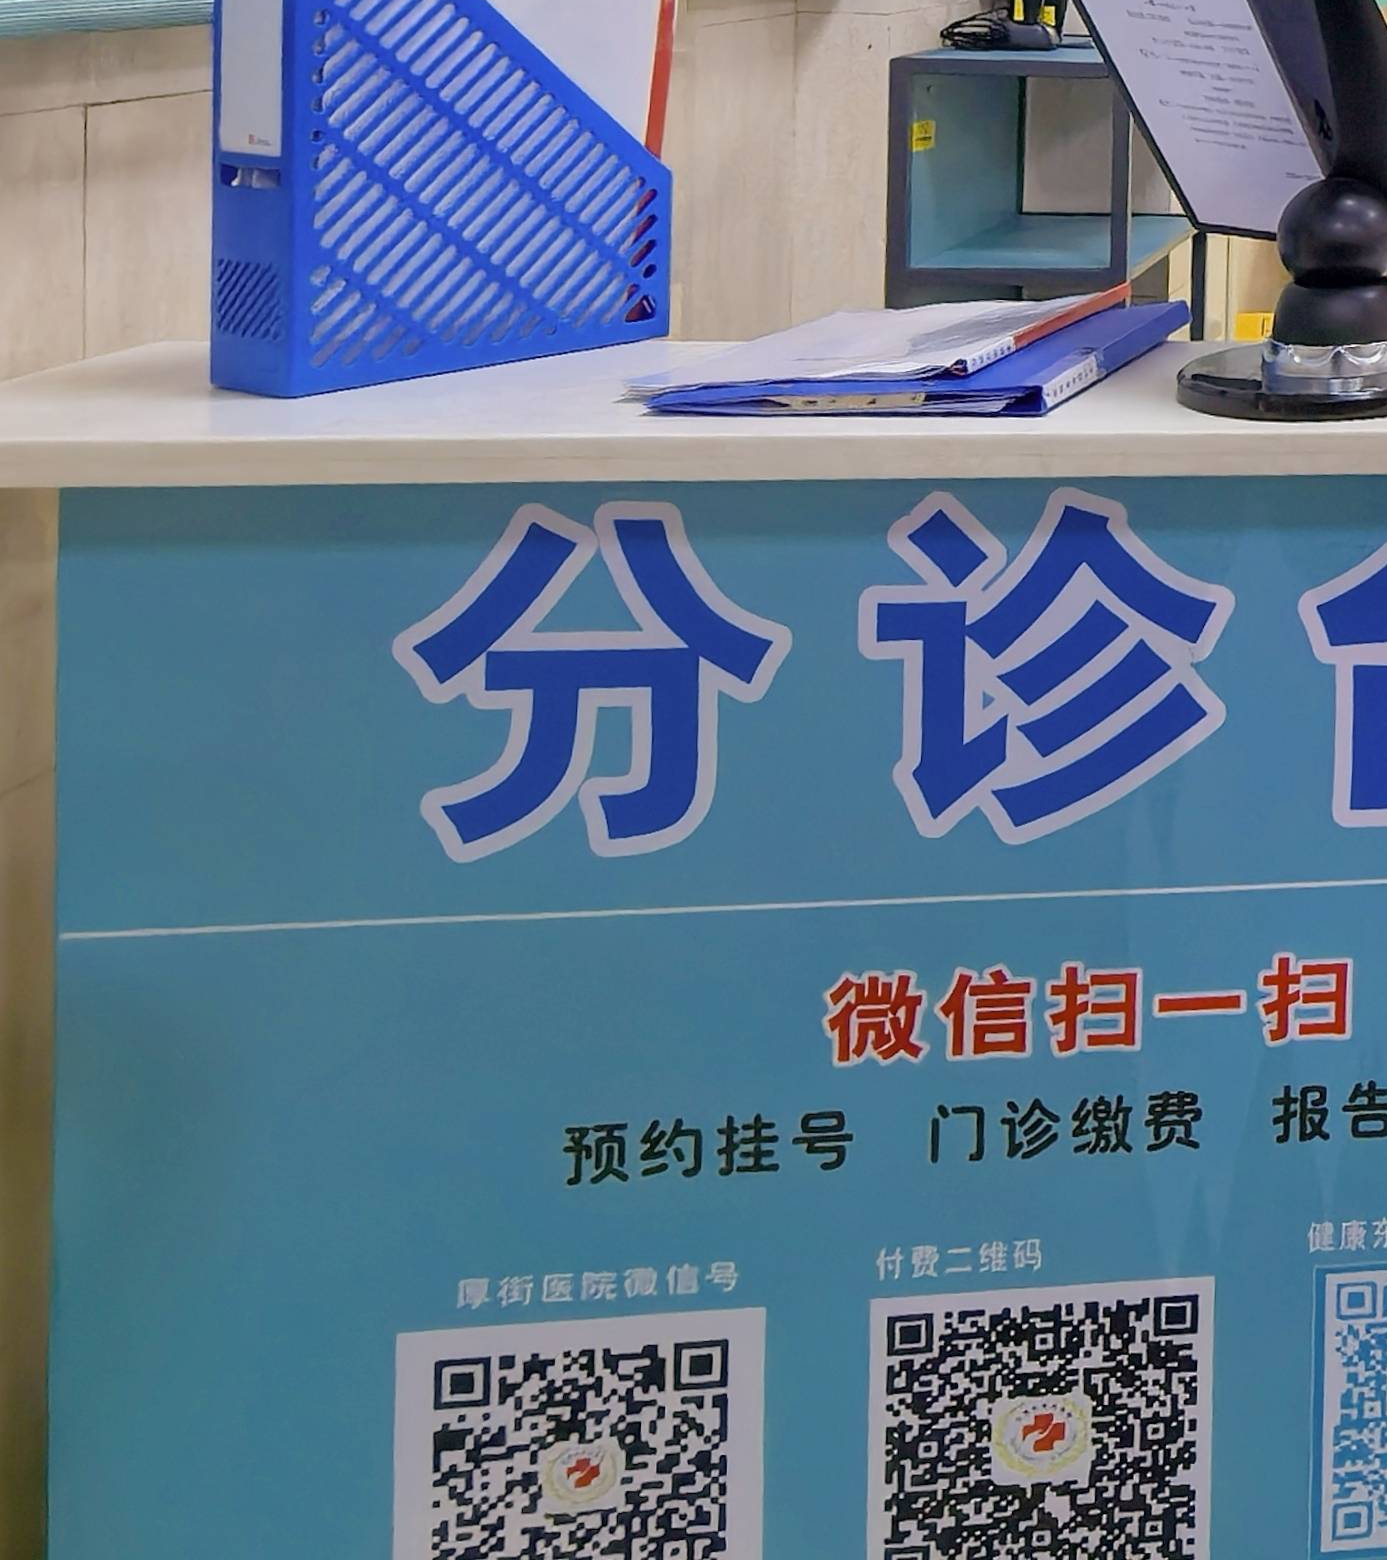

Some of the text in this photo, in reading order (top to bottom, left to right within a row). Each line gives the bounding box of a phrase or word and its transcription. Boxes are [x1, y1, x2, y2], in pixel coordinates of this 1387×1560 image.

[823, 952, 1354, 1069] 微信扫一扫
[561, 1109, 855, 1187] 预约挂号
[927, 1088, 1204, 1165] 门诊缴费
[455, 1261, 741, 1312] 厚街医院微信号
[874, 1238, 1044, 1283] 付费二维码
